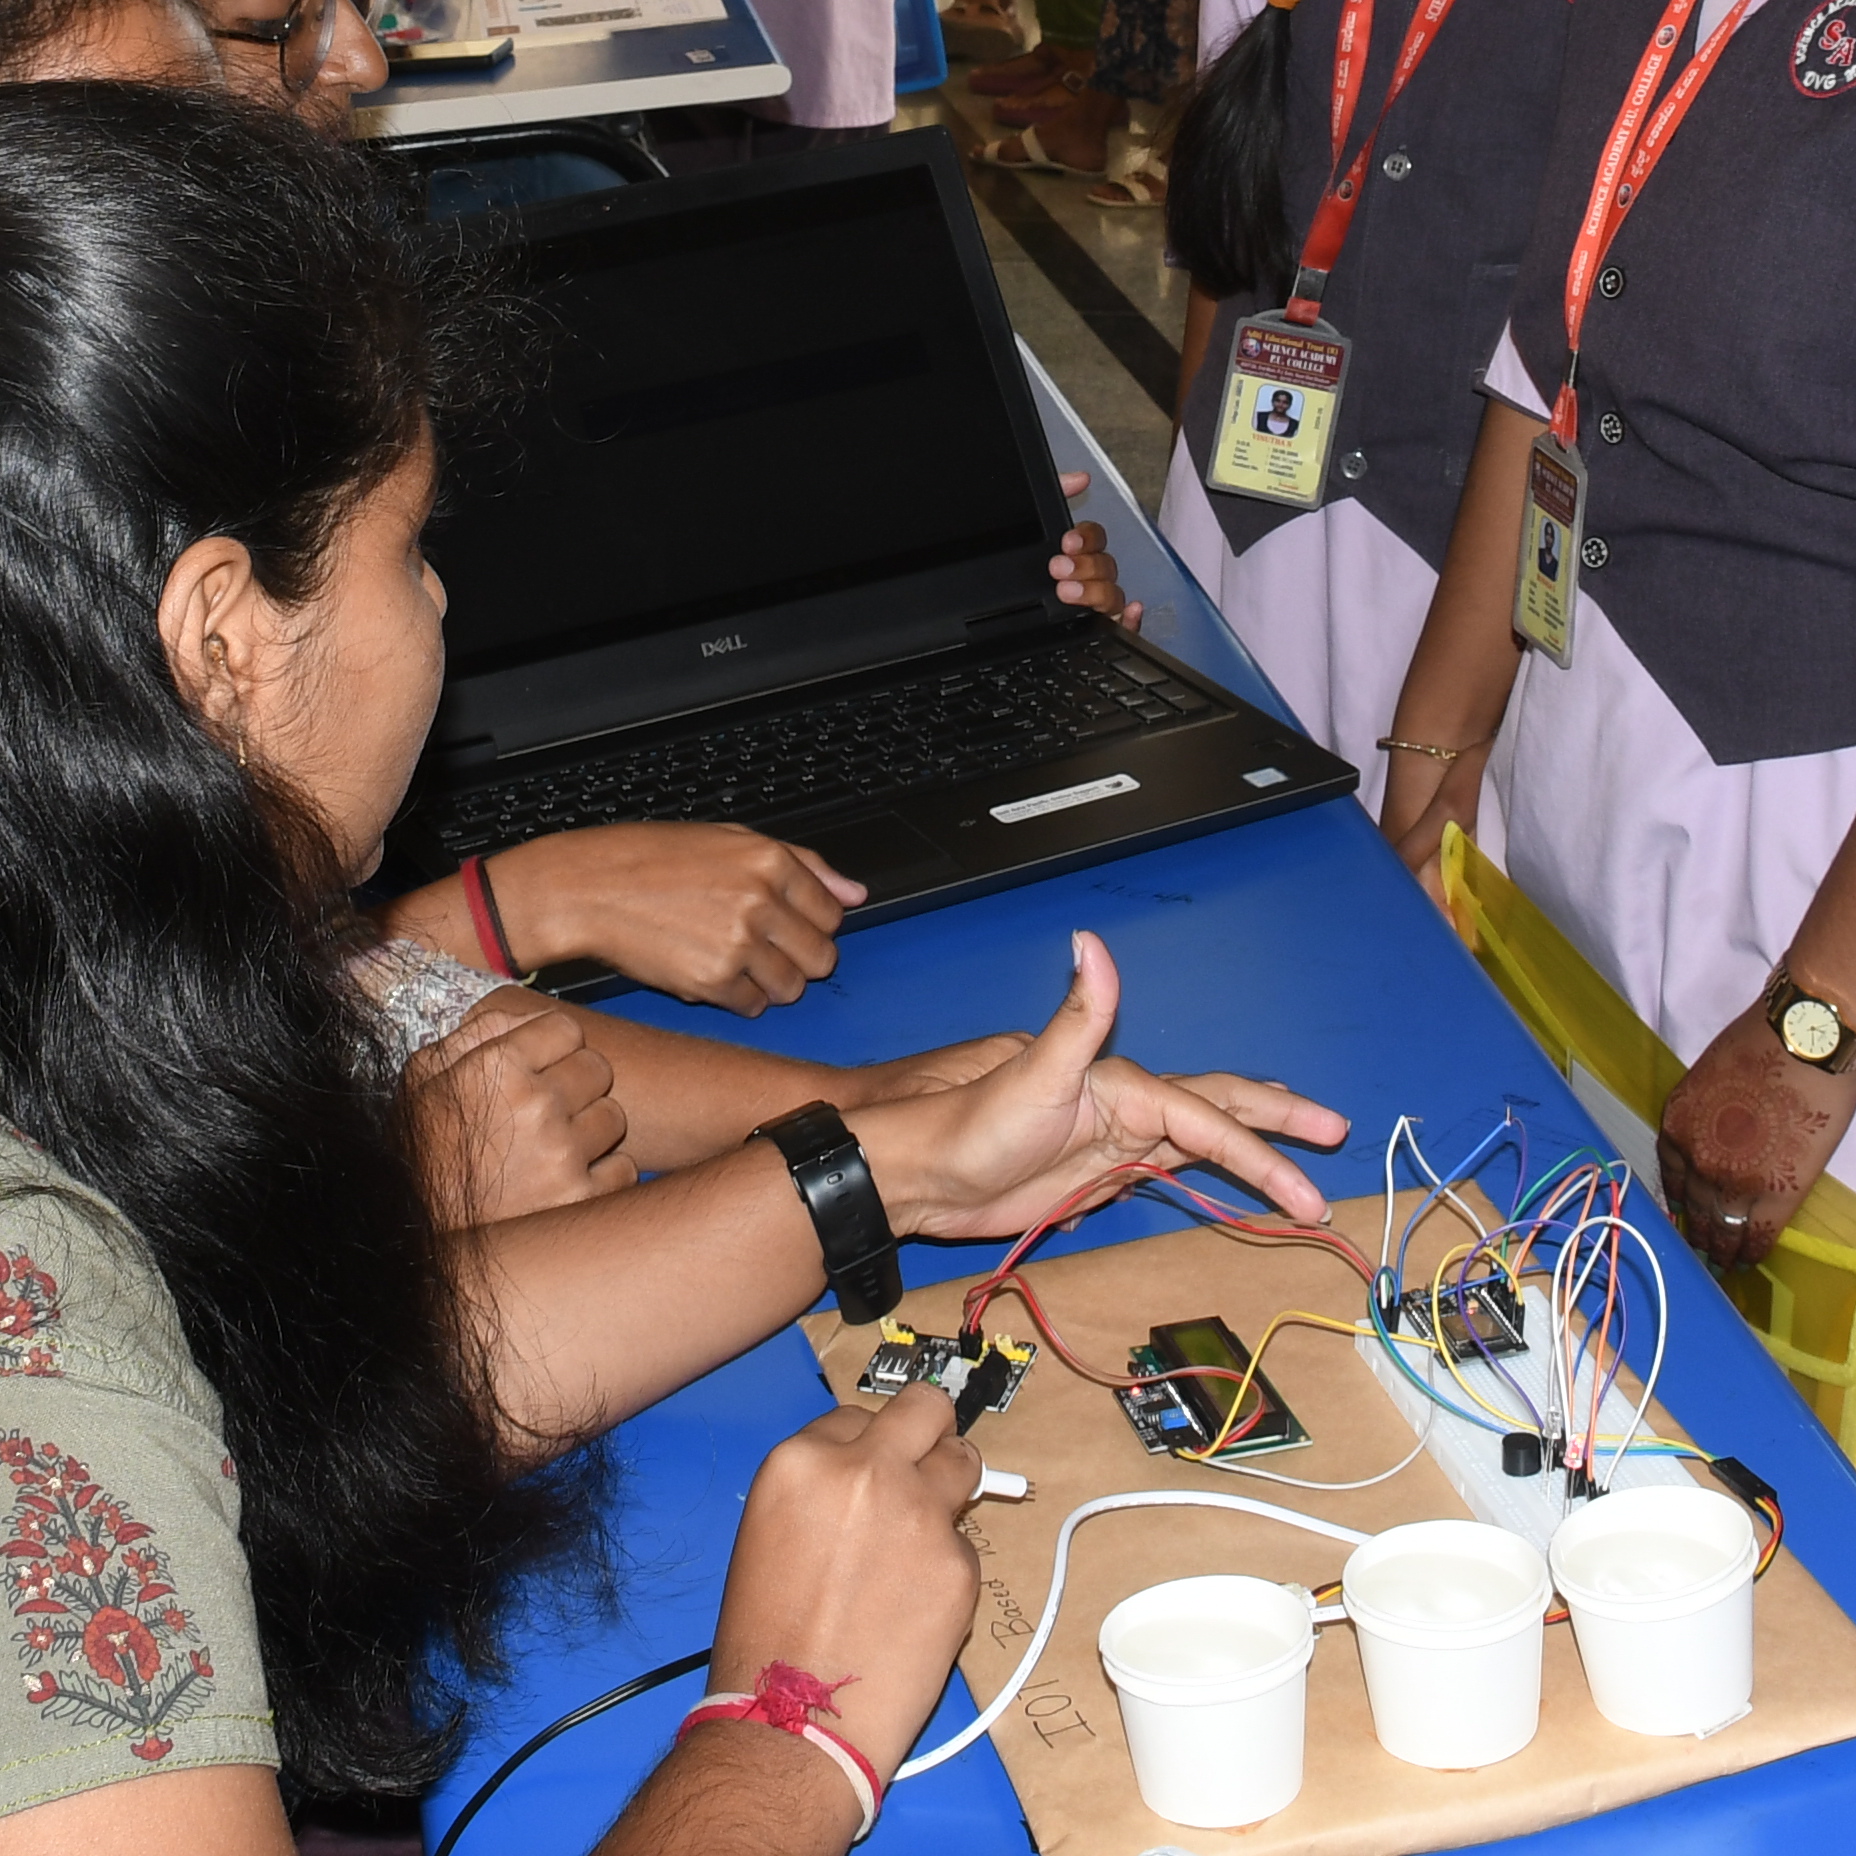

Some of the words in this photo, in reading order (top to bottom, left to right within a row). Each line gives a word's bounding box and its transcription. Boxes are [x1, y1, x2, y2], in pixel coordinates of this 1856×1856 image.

[1586, 185, 1610, 238] SCIENCE
[1600, 126, 1631, 186] ACADEMY
[1621, 107, 1640, 130] P.U.
[1631, 52, 1665, 108] COLLEGE
[1262, 342, 1298, 357] SCIENCE
[1299, 347, 1338, 366] ACADEMY
[1286, 357, 1326, 374] COLLEGE
[701, 634, 748, 657] DELL
[980, 1577, 1036, 1650] Based
